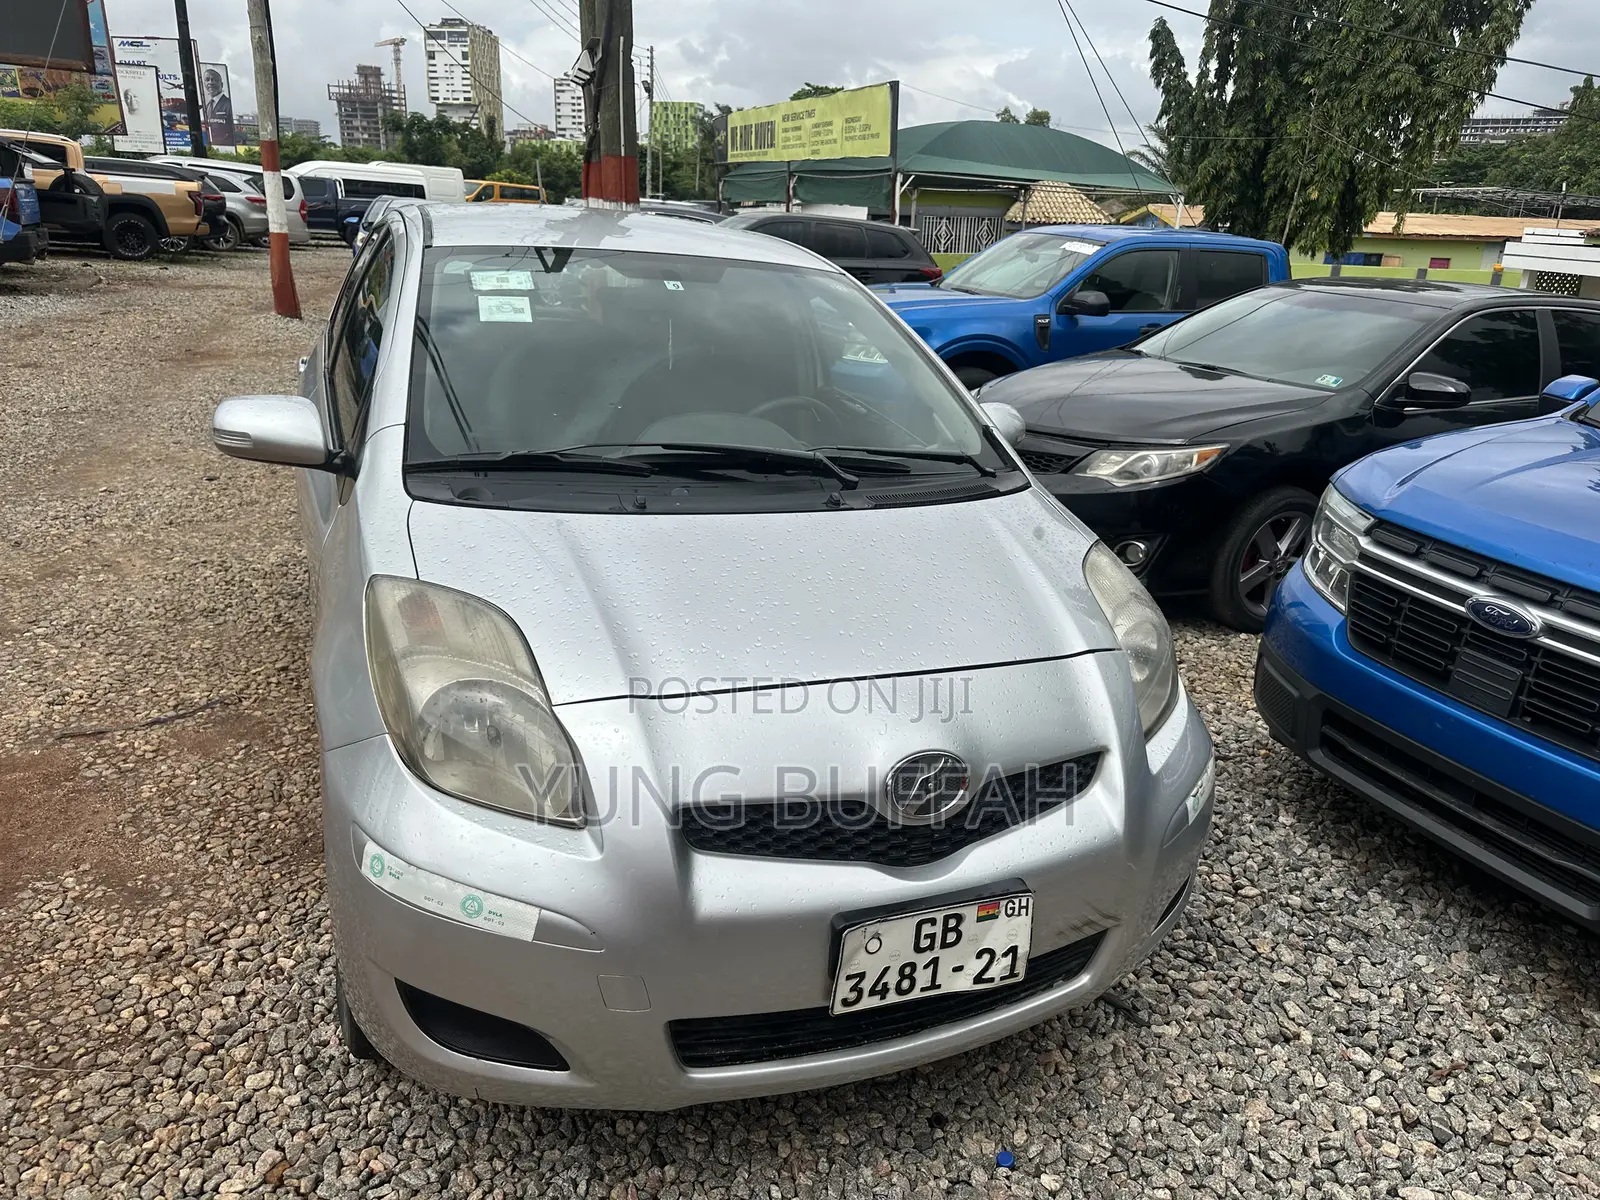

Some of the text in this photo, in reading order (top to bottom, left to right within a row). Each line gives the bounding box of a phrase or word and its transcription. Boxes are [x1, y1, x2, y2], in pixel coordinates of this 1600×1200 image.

[790, 110, 805, 121] SERVICE
[1481, 605, 1519, 630] Ford
[488, 909, 503, 918] DVLA
[913, 912, 964, 954] GB
[1004, 897, 1030, 918] GH
